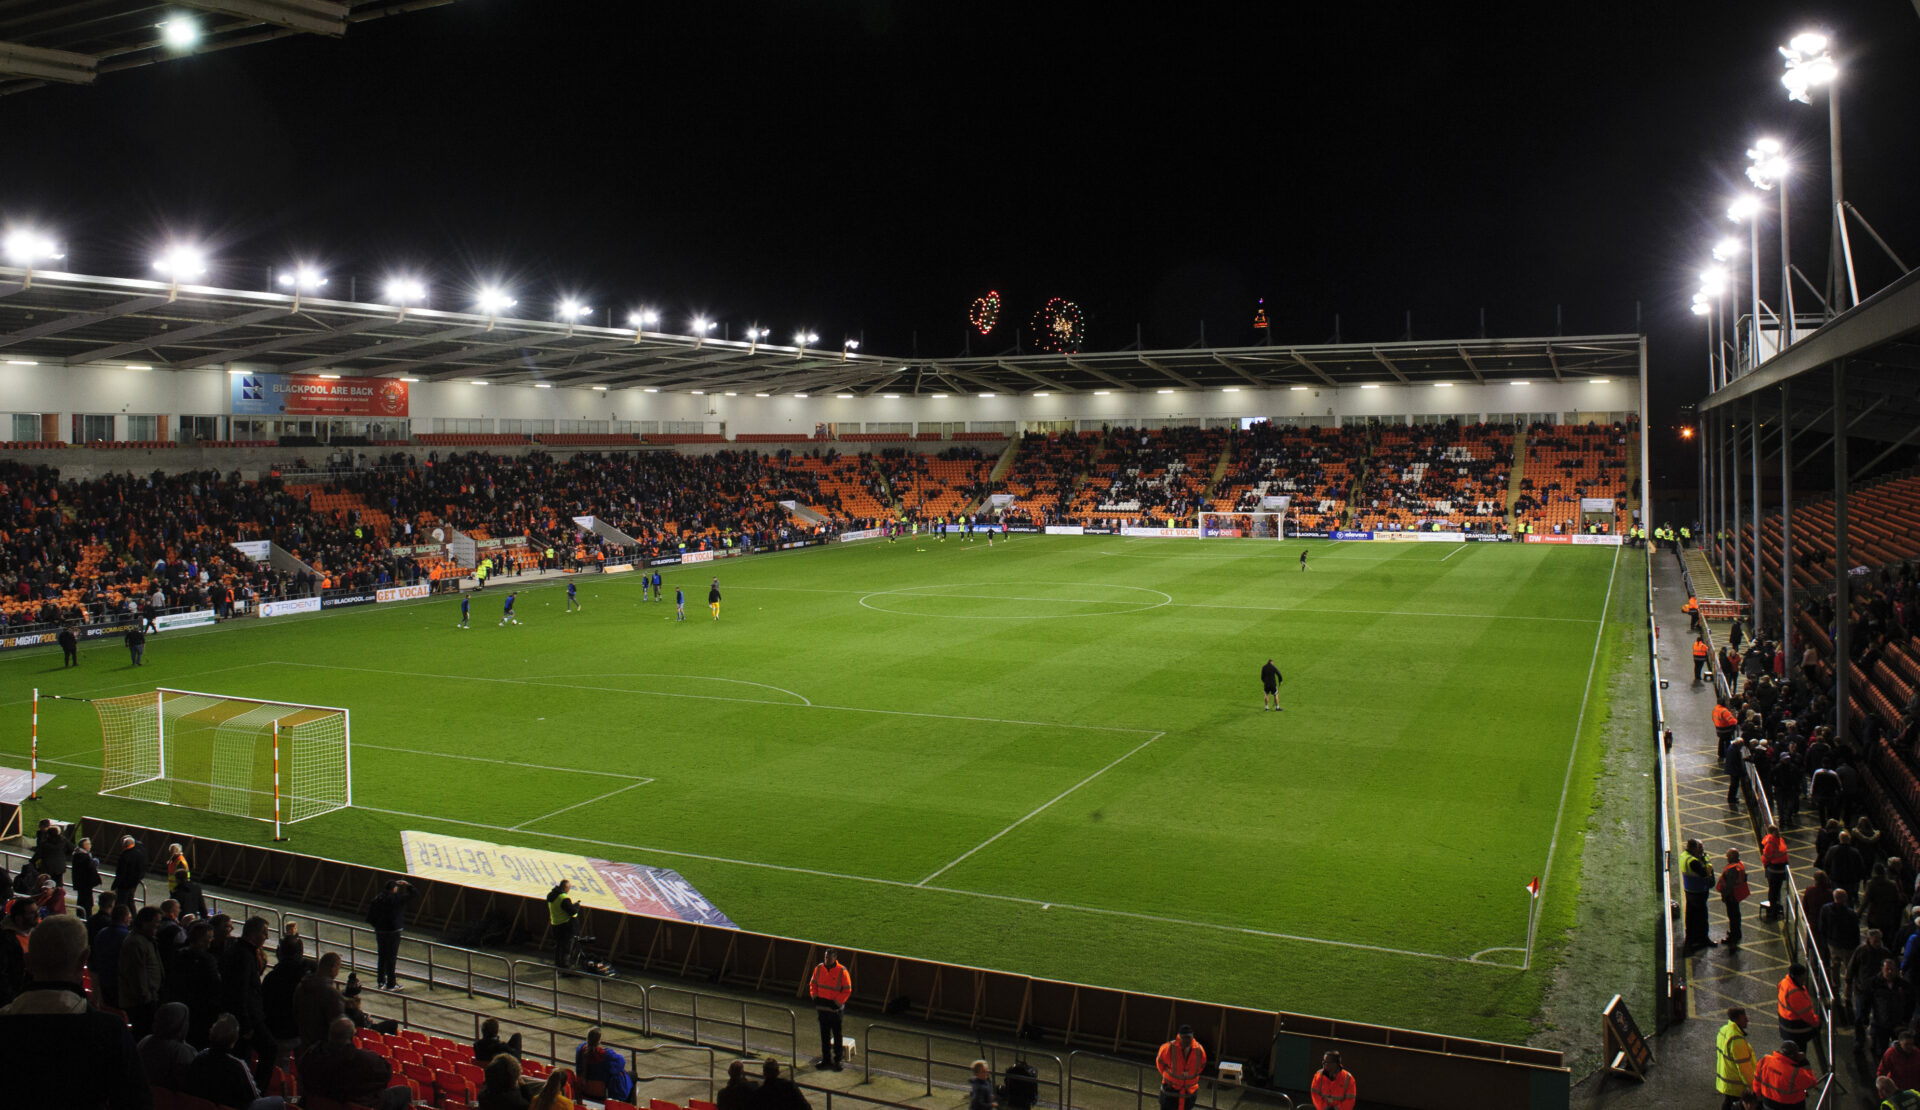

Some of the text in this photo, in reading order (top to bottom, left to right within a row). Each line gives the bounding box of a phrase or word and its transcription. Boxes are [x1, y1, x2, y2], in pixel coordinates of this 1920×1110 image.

[272, 384, 374, 396] BLACKPOOL ARE BACK
[682, 553, 693, 562] GET
[695, 551, 712, 561] VOCAL
[378, 585, 428, 601] GET VOCAL
[275, 599, 318, 610] TRIDENT
[322, 595, 376, 606] VISITBLACKPOOL.com
[418, 840, 496, 878] BETTER
[600, 869, 671, 913] bet
[646, 870, 710, 920] sky
